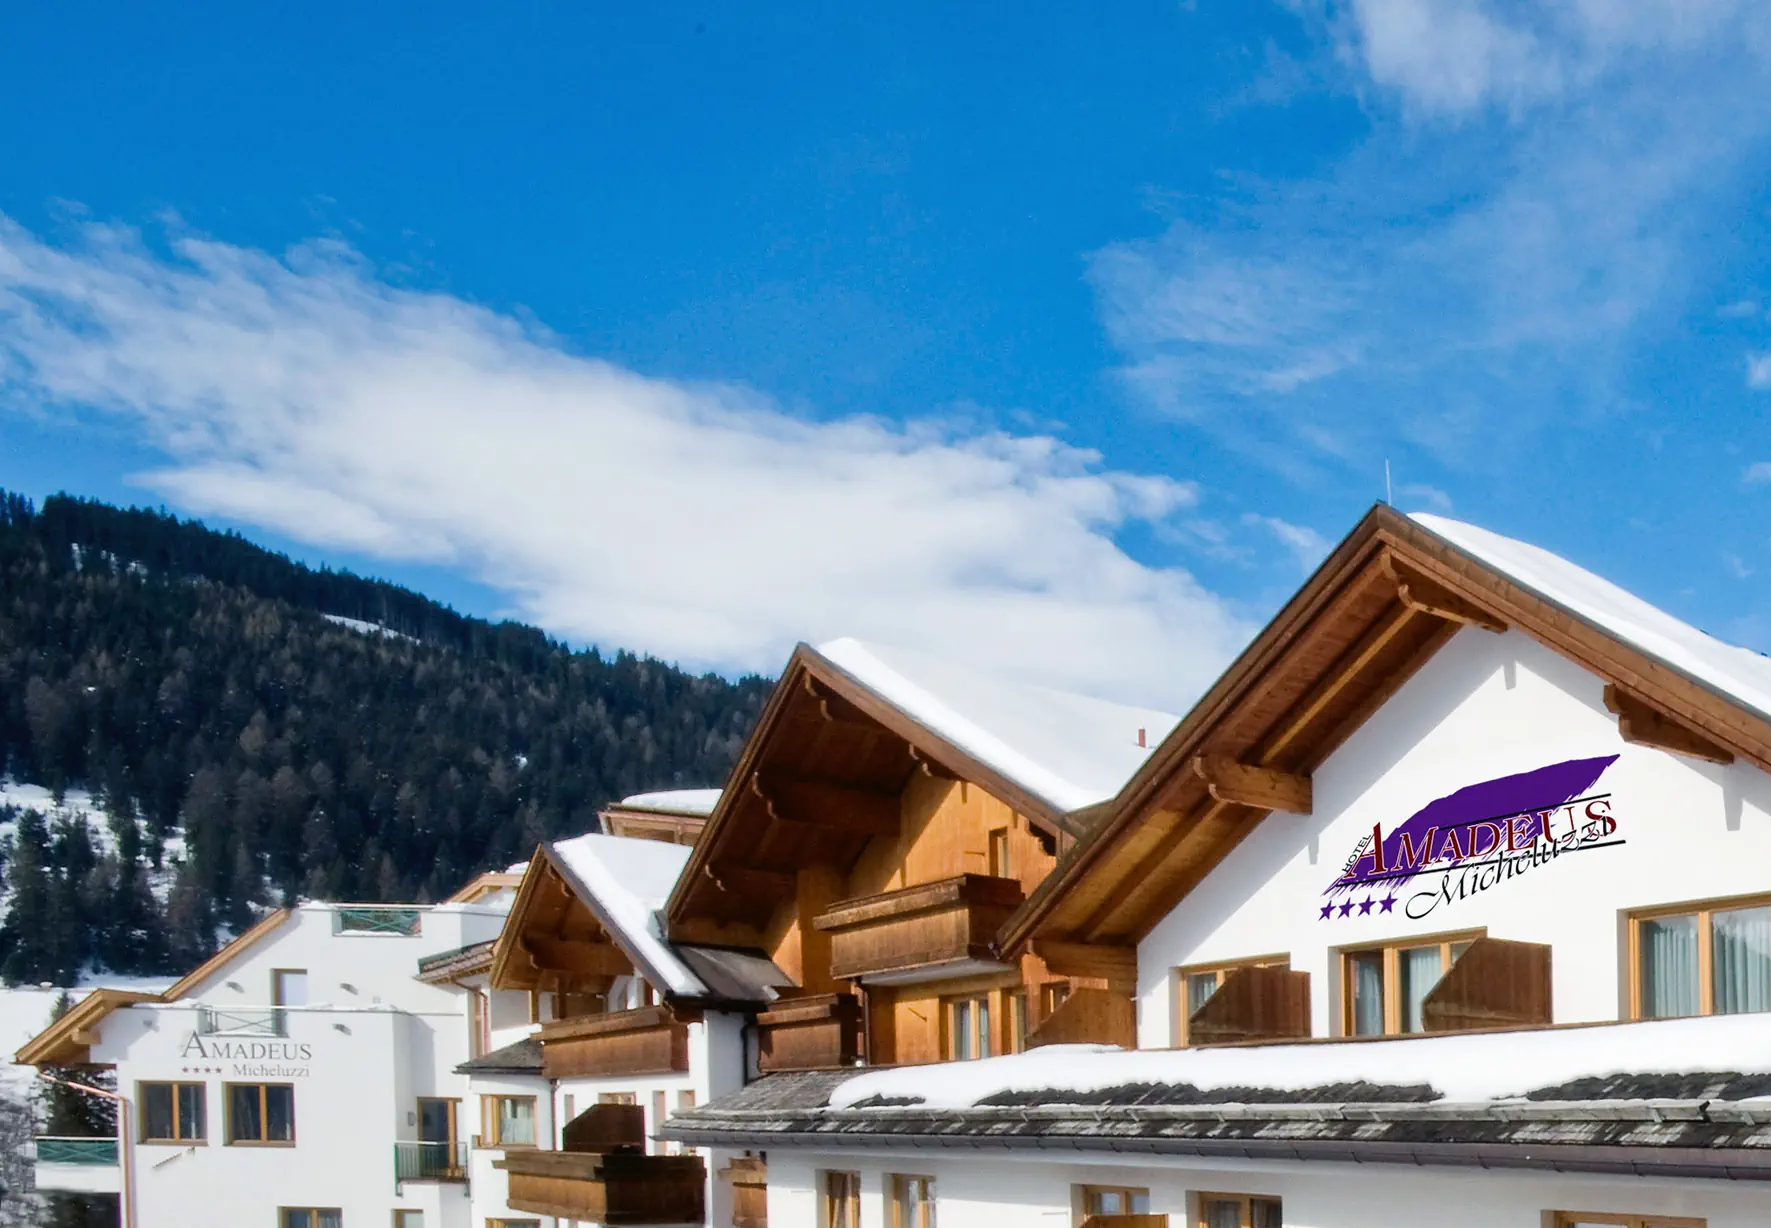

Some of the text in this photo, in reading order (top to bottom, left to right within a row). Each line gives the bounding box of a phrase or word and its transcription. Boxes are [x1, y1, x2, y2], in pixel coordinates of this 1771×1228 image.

[1341, 834, 1372, 874] HOTEL
[1343, 800, 1617, 879] AMADEUS
[1405, 809, 1612, 920] Micheluzzi
[181, 1030, 312, 1061] AMADEUS
[233, 1063, 310, 1078] Micheluzzi
